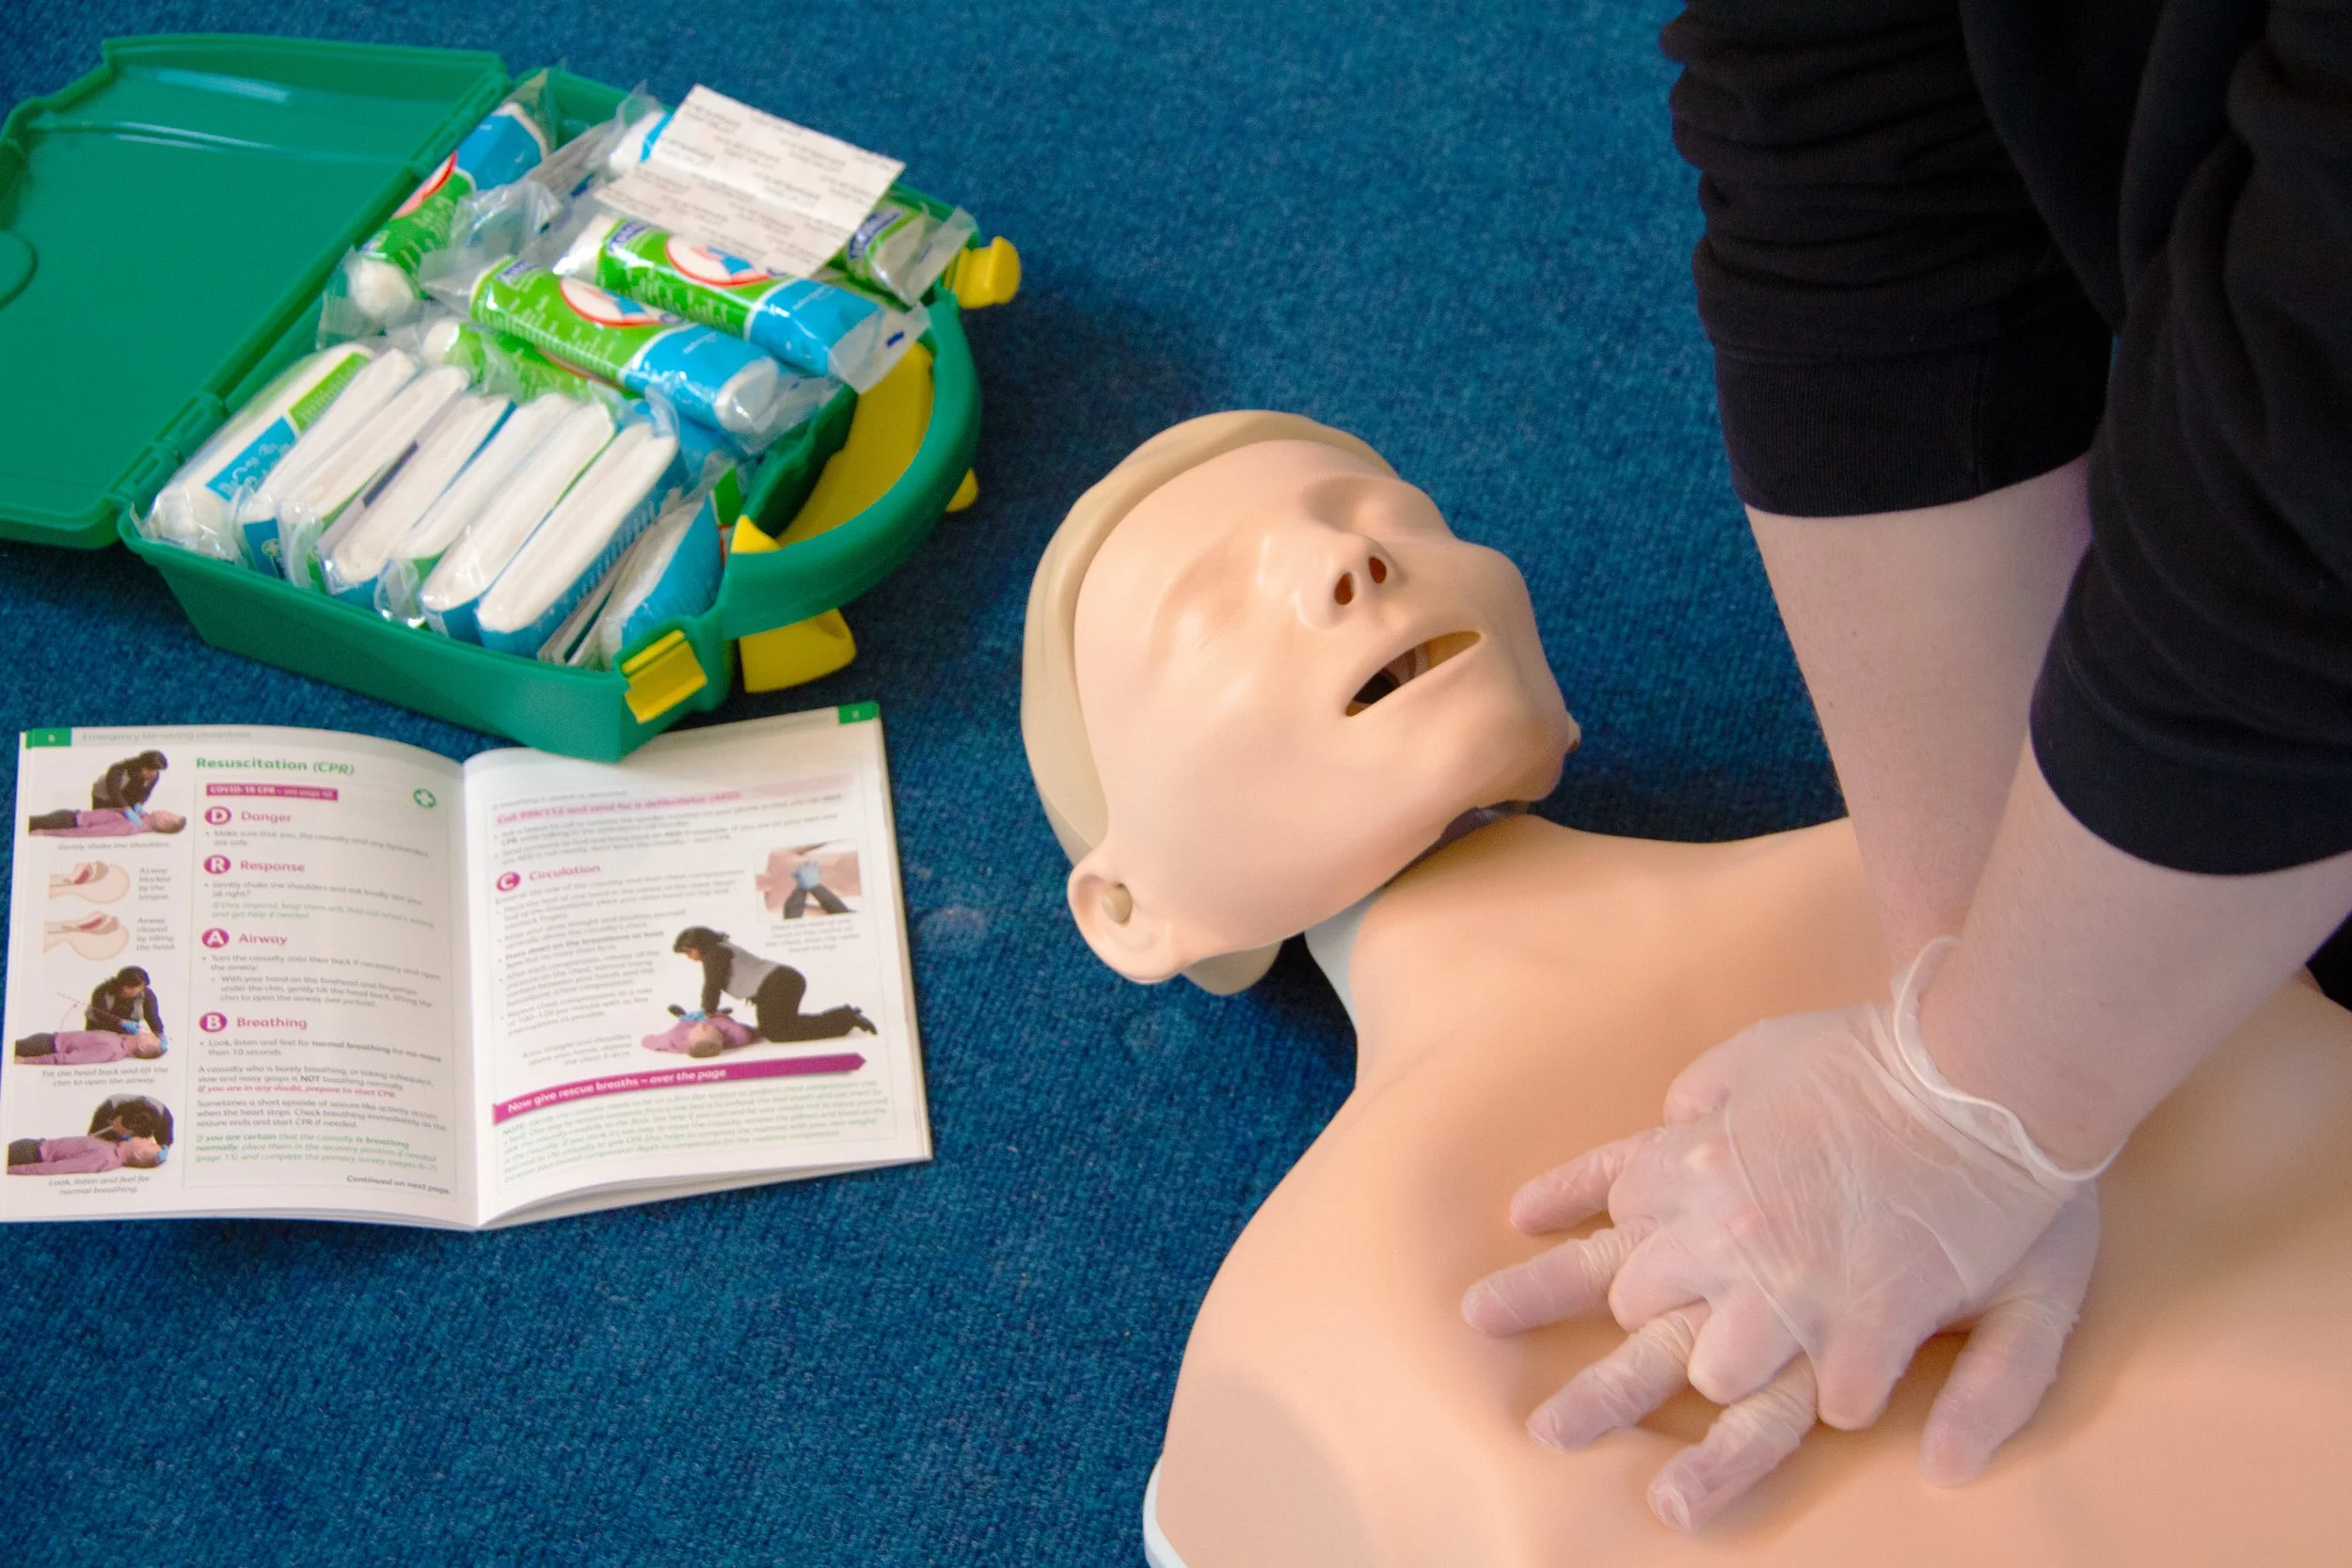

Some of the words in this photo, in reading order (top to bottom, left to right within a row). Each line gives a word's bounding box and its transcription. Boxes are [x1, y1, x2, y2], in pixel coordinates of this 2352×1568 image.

[197, 757, 307, 770] Resuscitation
[312, 760, 355, 775] (CPR)
[258, 786, 275, 795] CPR
[211, 810, 227, 822] D
[241, 812, 291, 822] Danger
[211, 858, 225, 872] R
[240, 861, 306, 873] Response
[530, 864, 600, 881] Circulation
[208, 931, 224, 944] A
[238, 934, 287, 945] Airway
[207, 1014, 221, 1028] B
[237, 1018, 307, 1030] Breathing
[508, 1100, 532, 1113] Now
[534, 1094, 557, 1106] give
[559, 1085, 595, 1098] rescue
[596, 1078, 639, 1089] breaths
[650, 1074, 674, 1084] over
[676, 1070, 695, 1080] the
[698, 1069, 726, 1080] page
